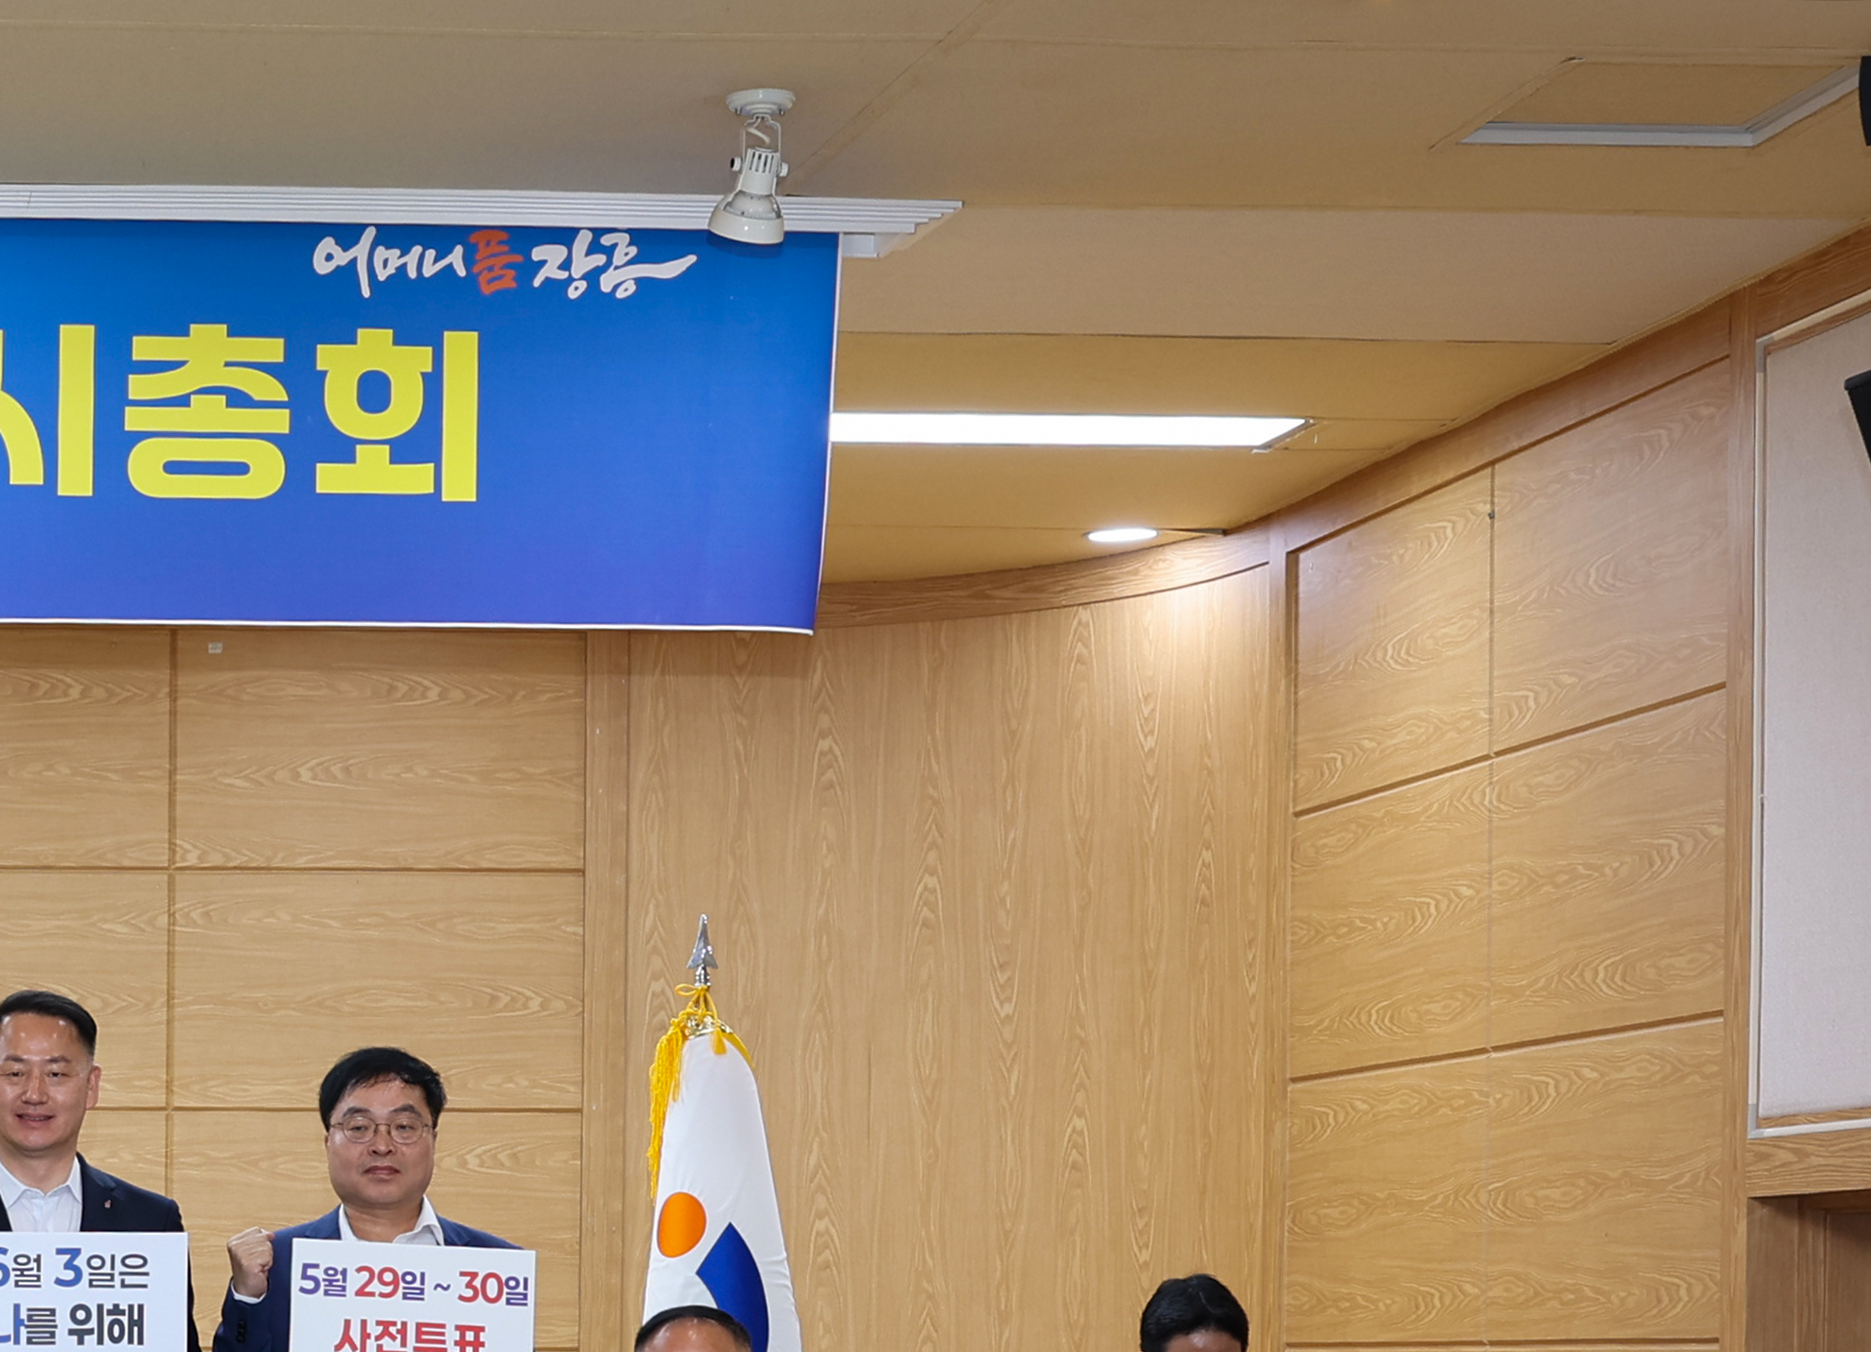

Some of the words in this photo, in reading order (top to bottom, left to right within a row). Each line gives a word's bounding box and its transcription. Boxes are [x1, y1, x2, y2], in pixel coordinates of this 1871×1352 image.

[531, 229, 697, 299] 장흥
[54, 1248, 150, 1288] 3일은
[299, 1263, 347, 1297] 5월
[355, 1266, 425, 1301] 29일
[458, 1271, 528, 1306] 30일
[68, 1303, 144, 1345] 위해
